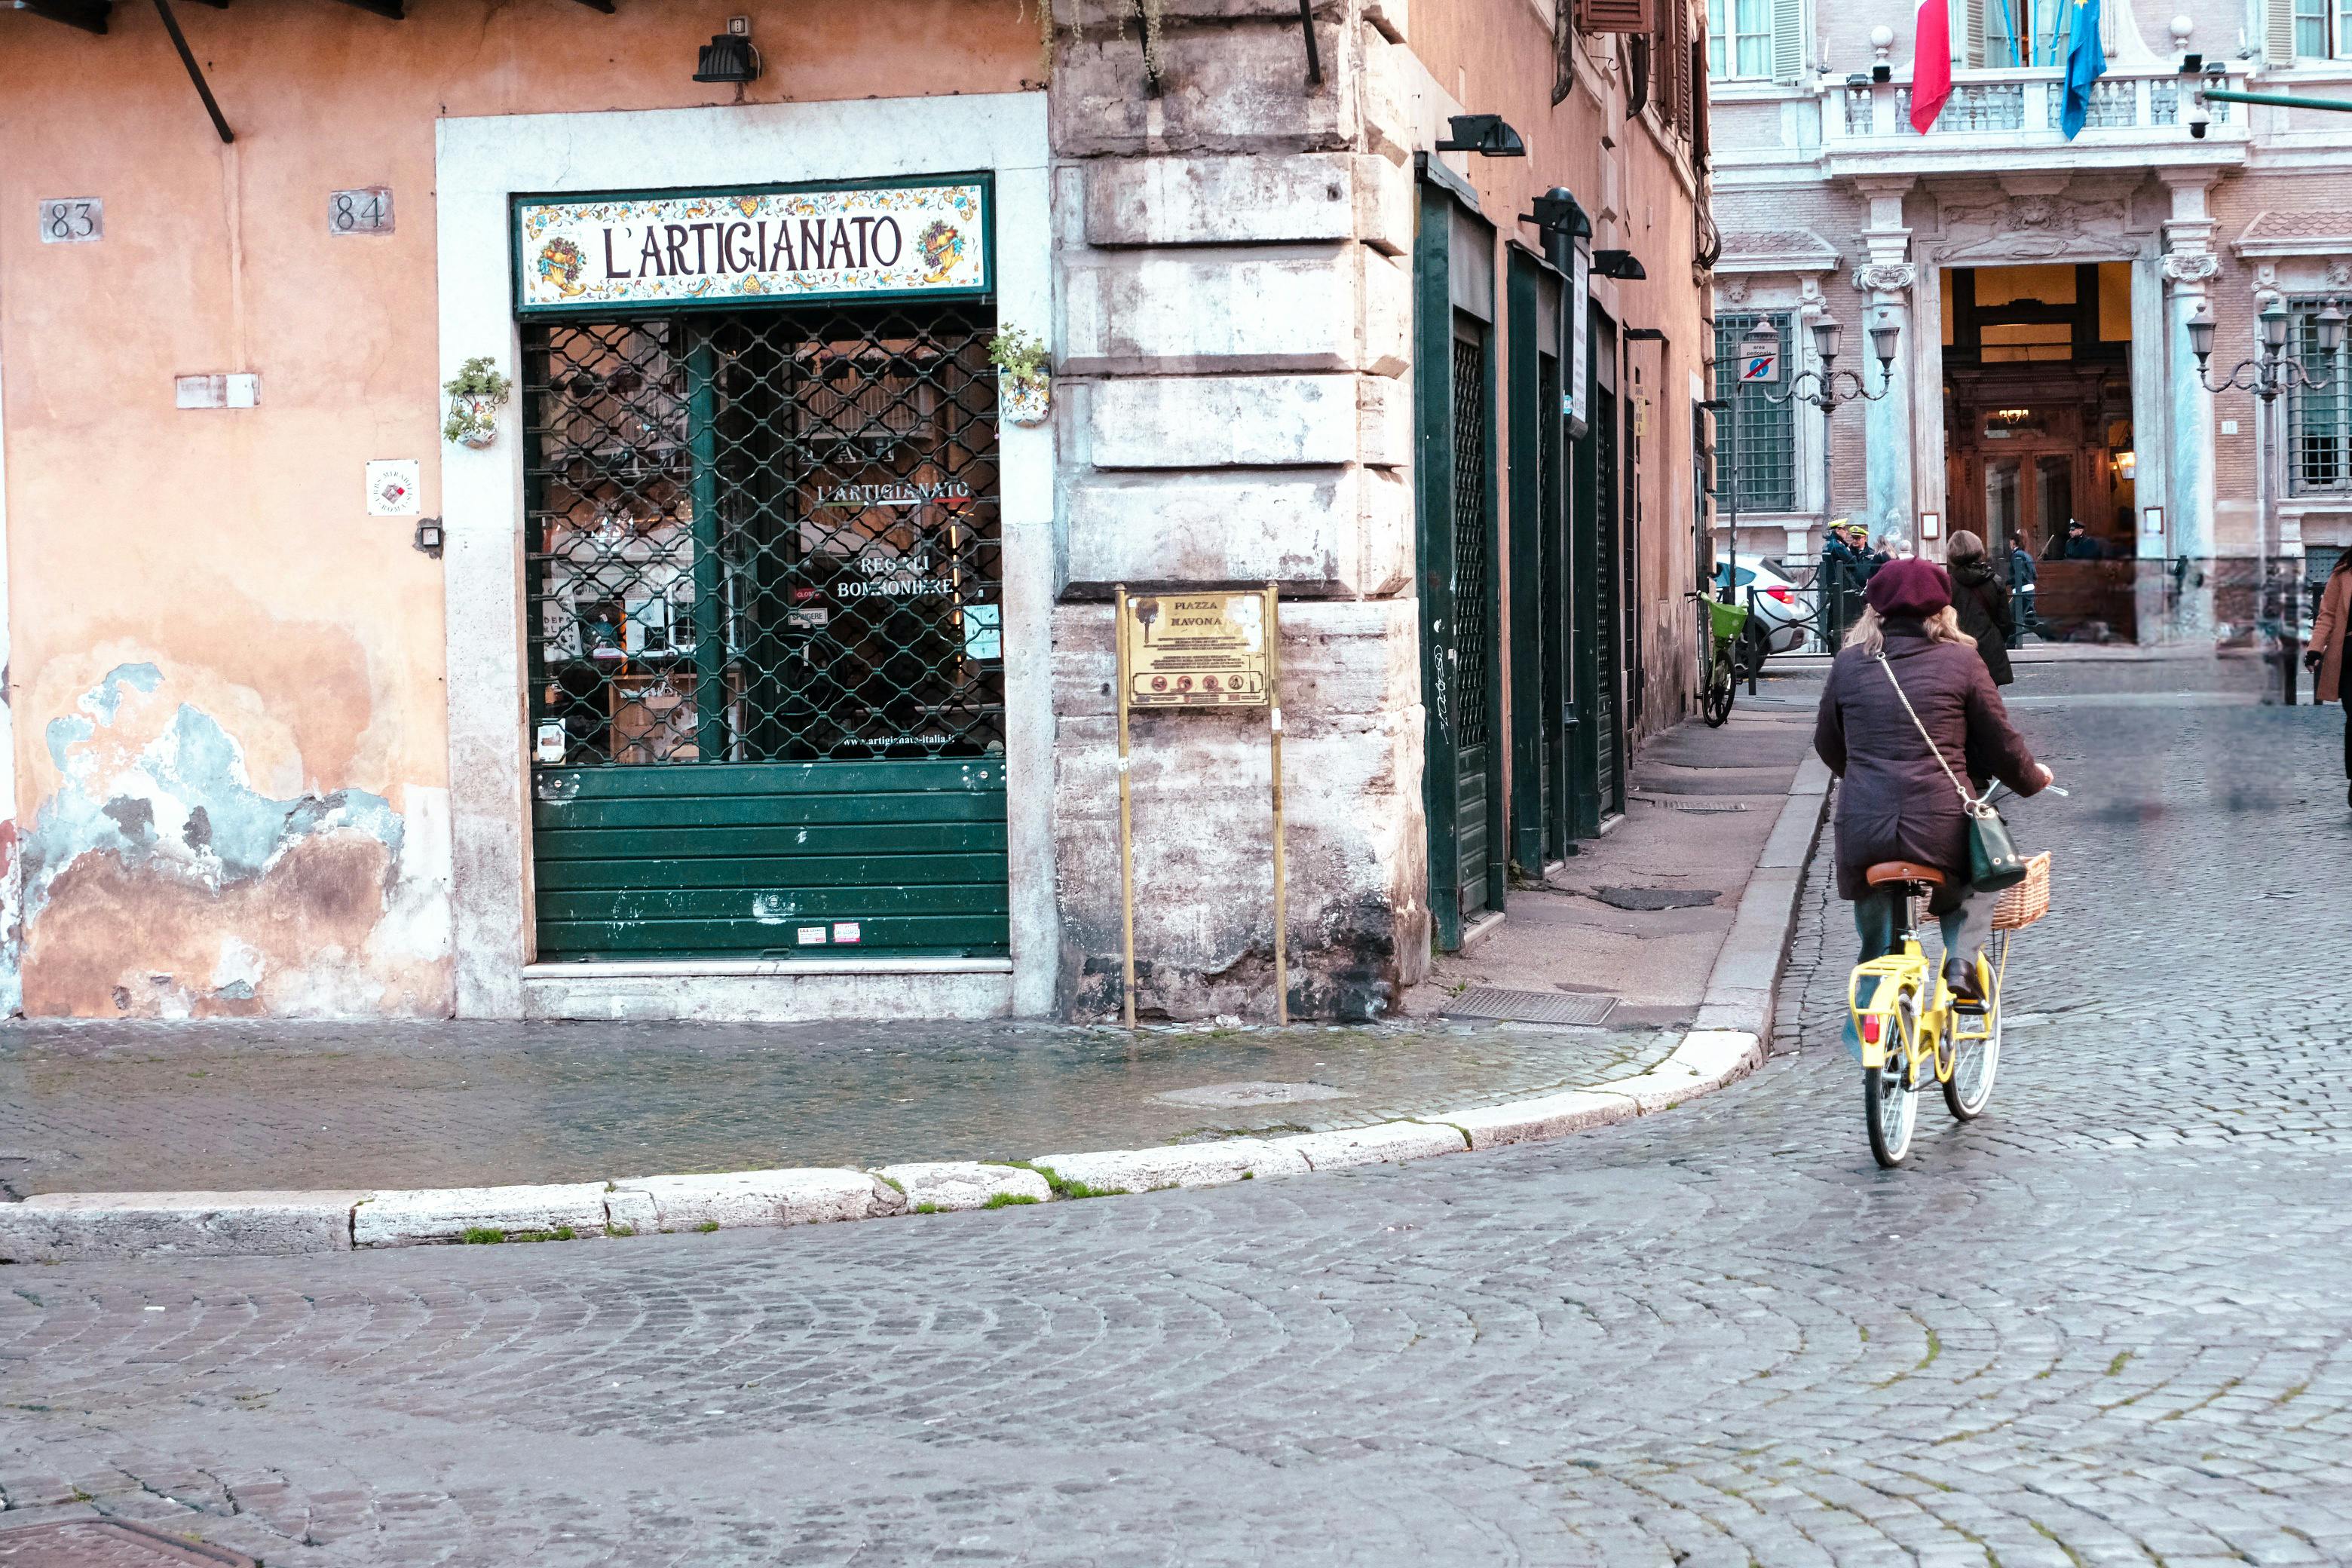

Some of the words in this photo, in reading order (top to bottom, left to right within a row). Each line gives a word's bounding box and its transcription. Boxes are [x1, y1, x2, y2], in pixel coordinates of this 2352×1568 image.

[52, 203, 93, 237] 83
[337, 194, 385, 230] 84
[602, 215, 902, 280] L'ARTIGIANATO
[1174, 602, 1218, 610] PIAZZA
